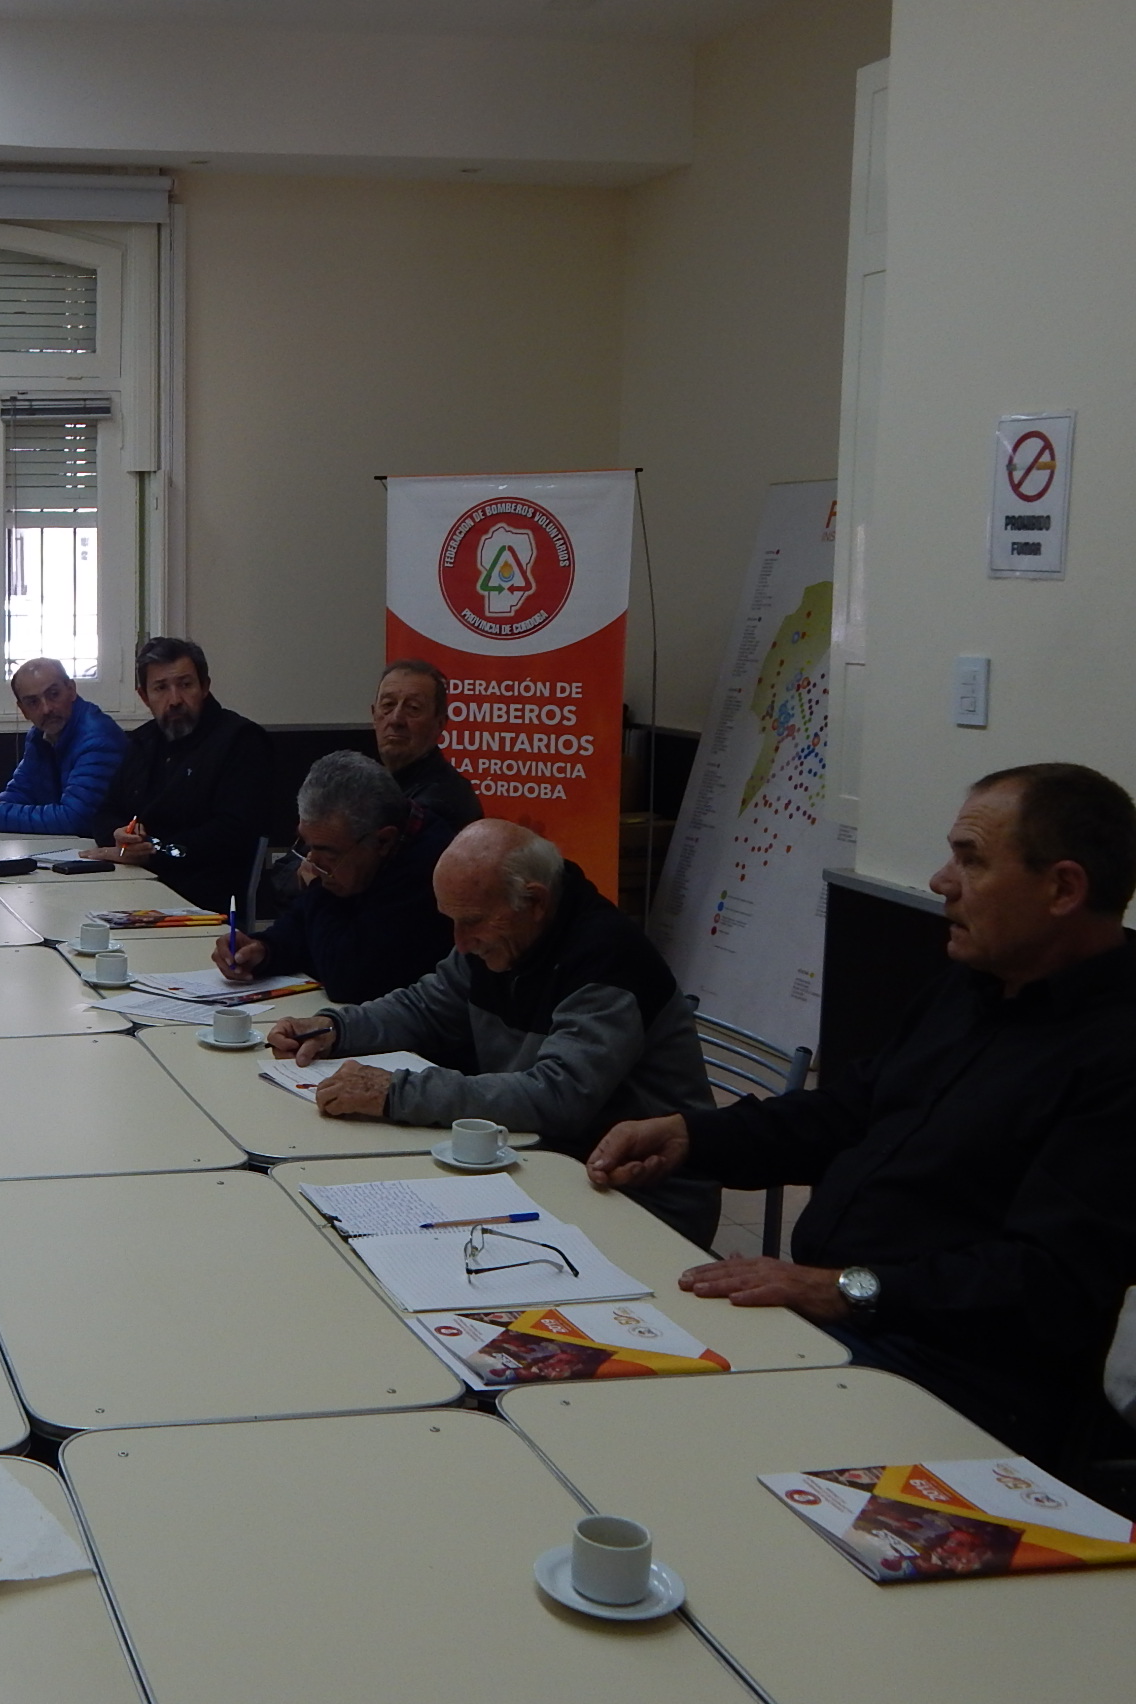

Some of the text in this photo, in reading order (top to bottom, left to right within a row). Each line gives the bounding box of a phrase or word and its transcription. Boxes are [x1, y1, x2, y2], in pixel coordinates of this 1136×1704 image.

[473, 509, 485, 521] DE
[485, 503, 535, 517] BOMBEROS
[533, 512, 570, 567] VOLUNTARIOS
[446, 677, 583, 698] DERACIÓN DE
[447, 701, 577, 726] OMBEROS
[437, 729, 595, 756] OLUNTARIOS
[478, 758, 587, 779] PROVINCIA
